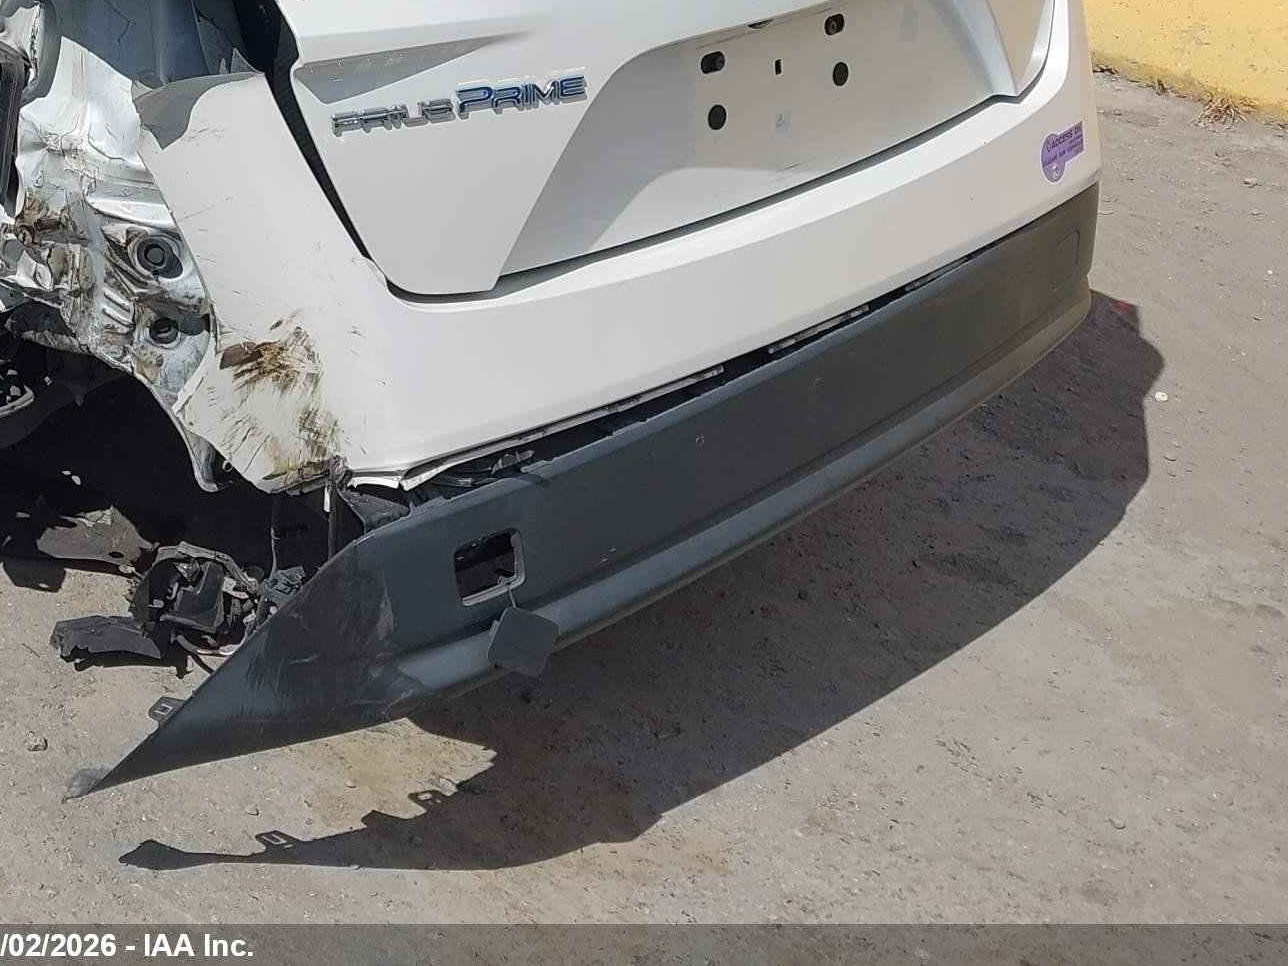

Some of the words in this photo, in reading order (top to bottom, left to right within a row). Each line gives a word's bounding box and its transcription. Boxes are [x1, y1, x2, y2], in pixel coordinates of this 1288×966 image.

[331, 98, 456, 137] PRIUS
[455, 74, 588, 120] PRIME
[1051, 129, 1073, 149] ACCESS
